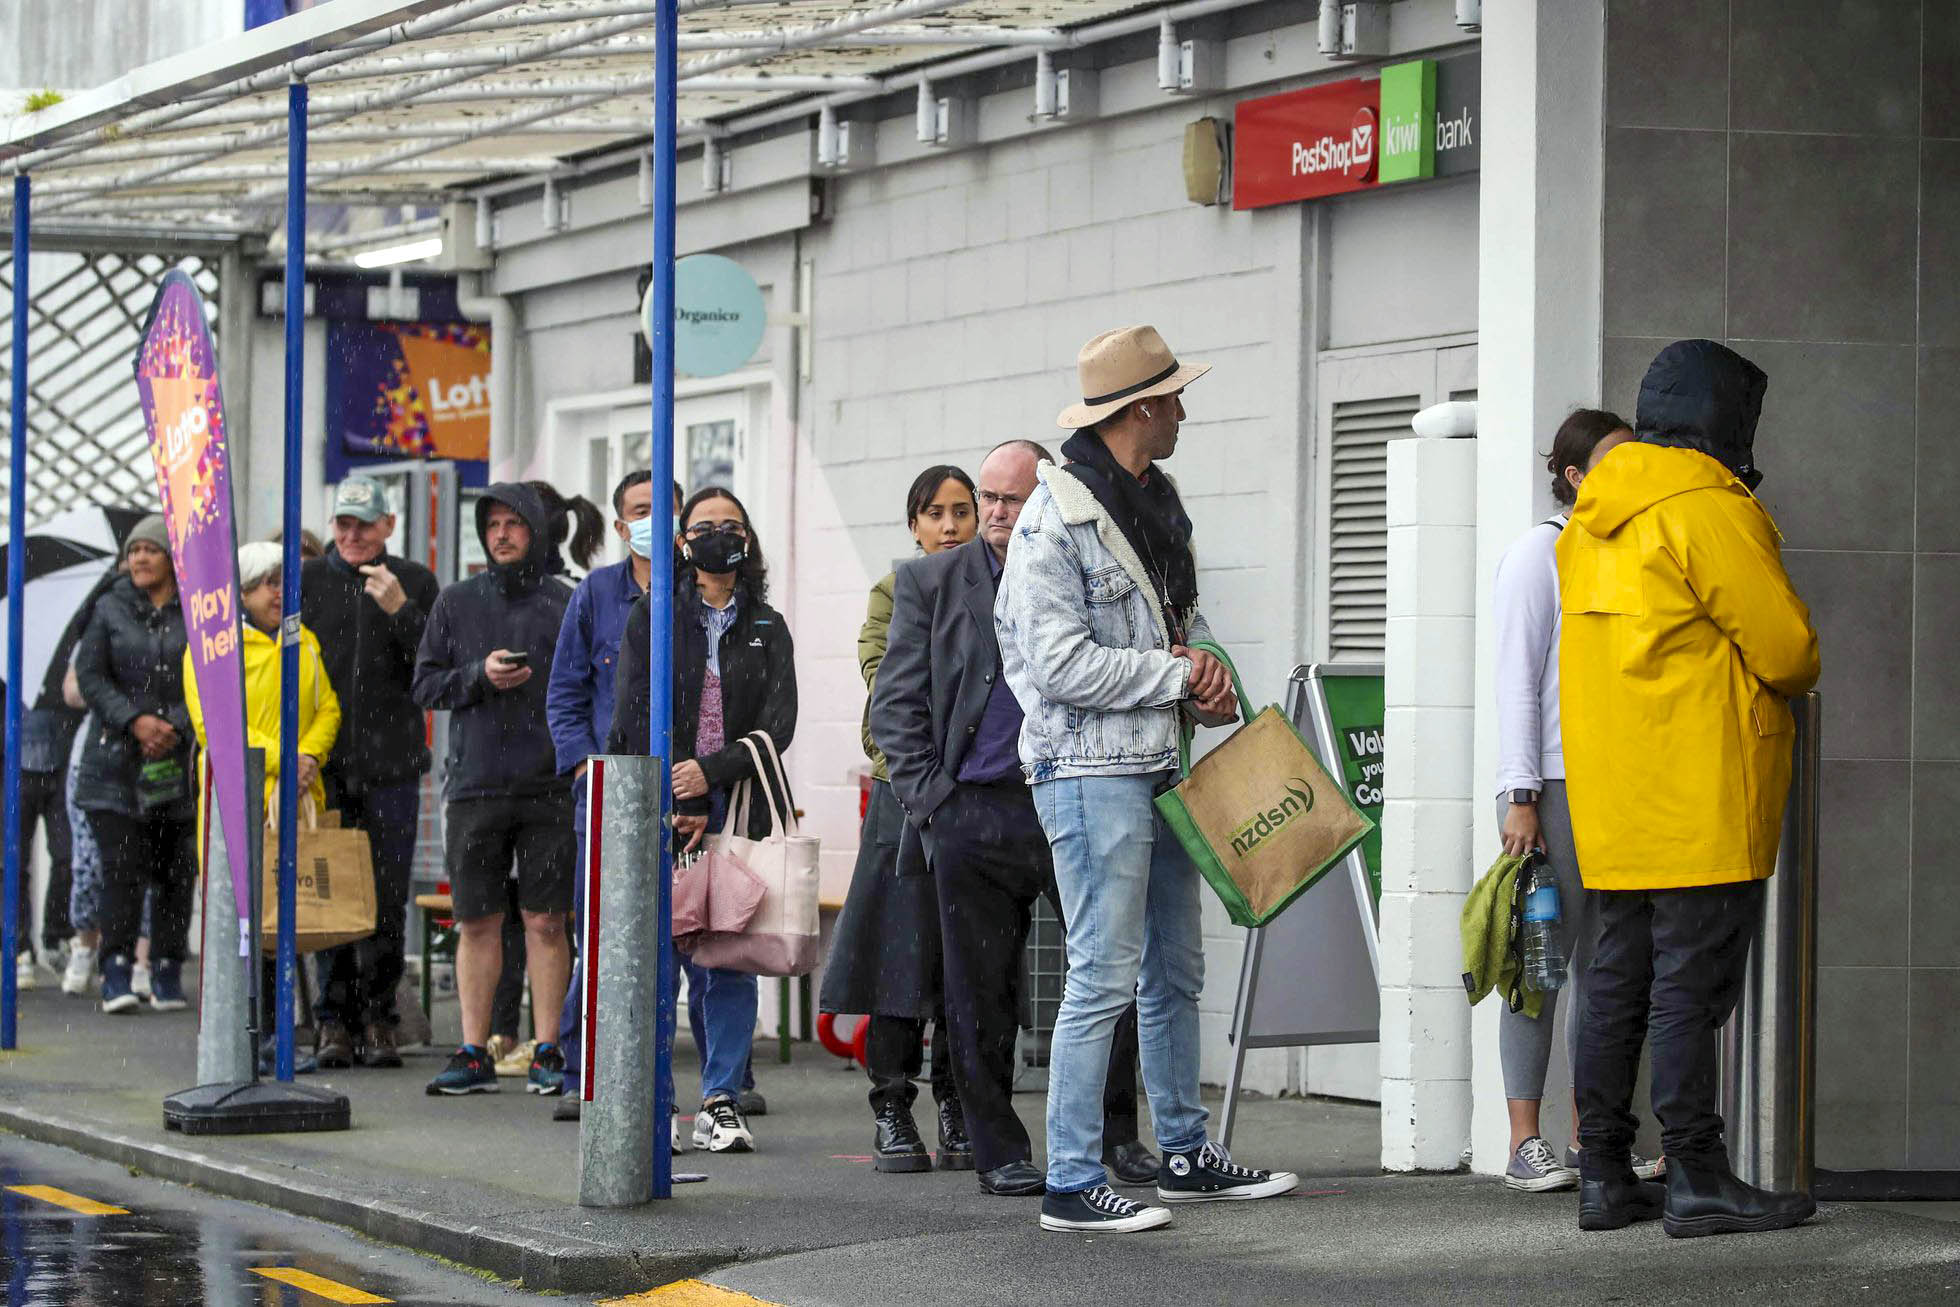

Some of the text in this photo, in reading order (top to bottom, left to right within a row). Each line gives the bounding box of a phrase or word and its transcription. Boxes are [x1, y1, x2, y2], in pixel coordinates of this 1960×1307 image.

[1386, 106, 1473, 156] kiwi bank
[1292, 136, 1351, 176] PostShop
[674, 306, 741, 324] Organico
[166, 406, 207, 461] Lotto
[190, 583, 231, 632] Play
[202, 618, 238, 666] her
[1350, 730, 1384, 756] Val
[1355, 783, 1383, 805] Co
[1231, 796, 1300, 857] nzdsn
